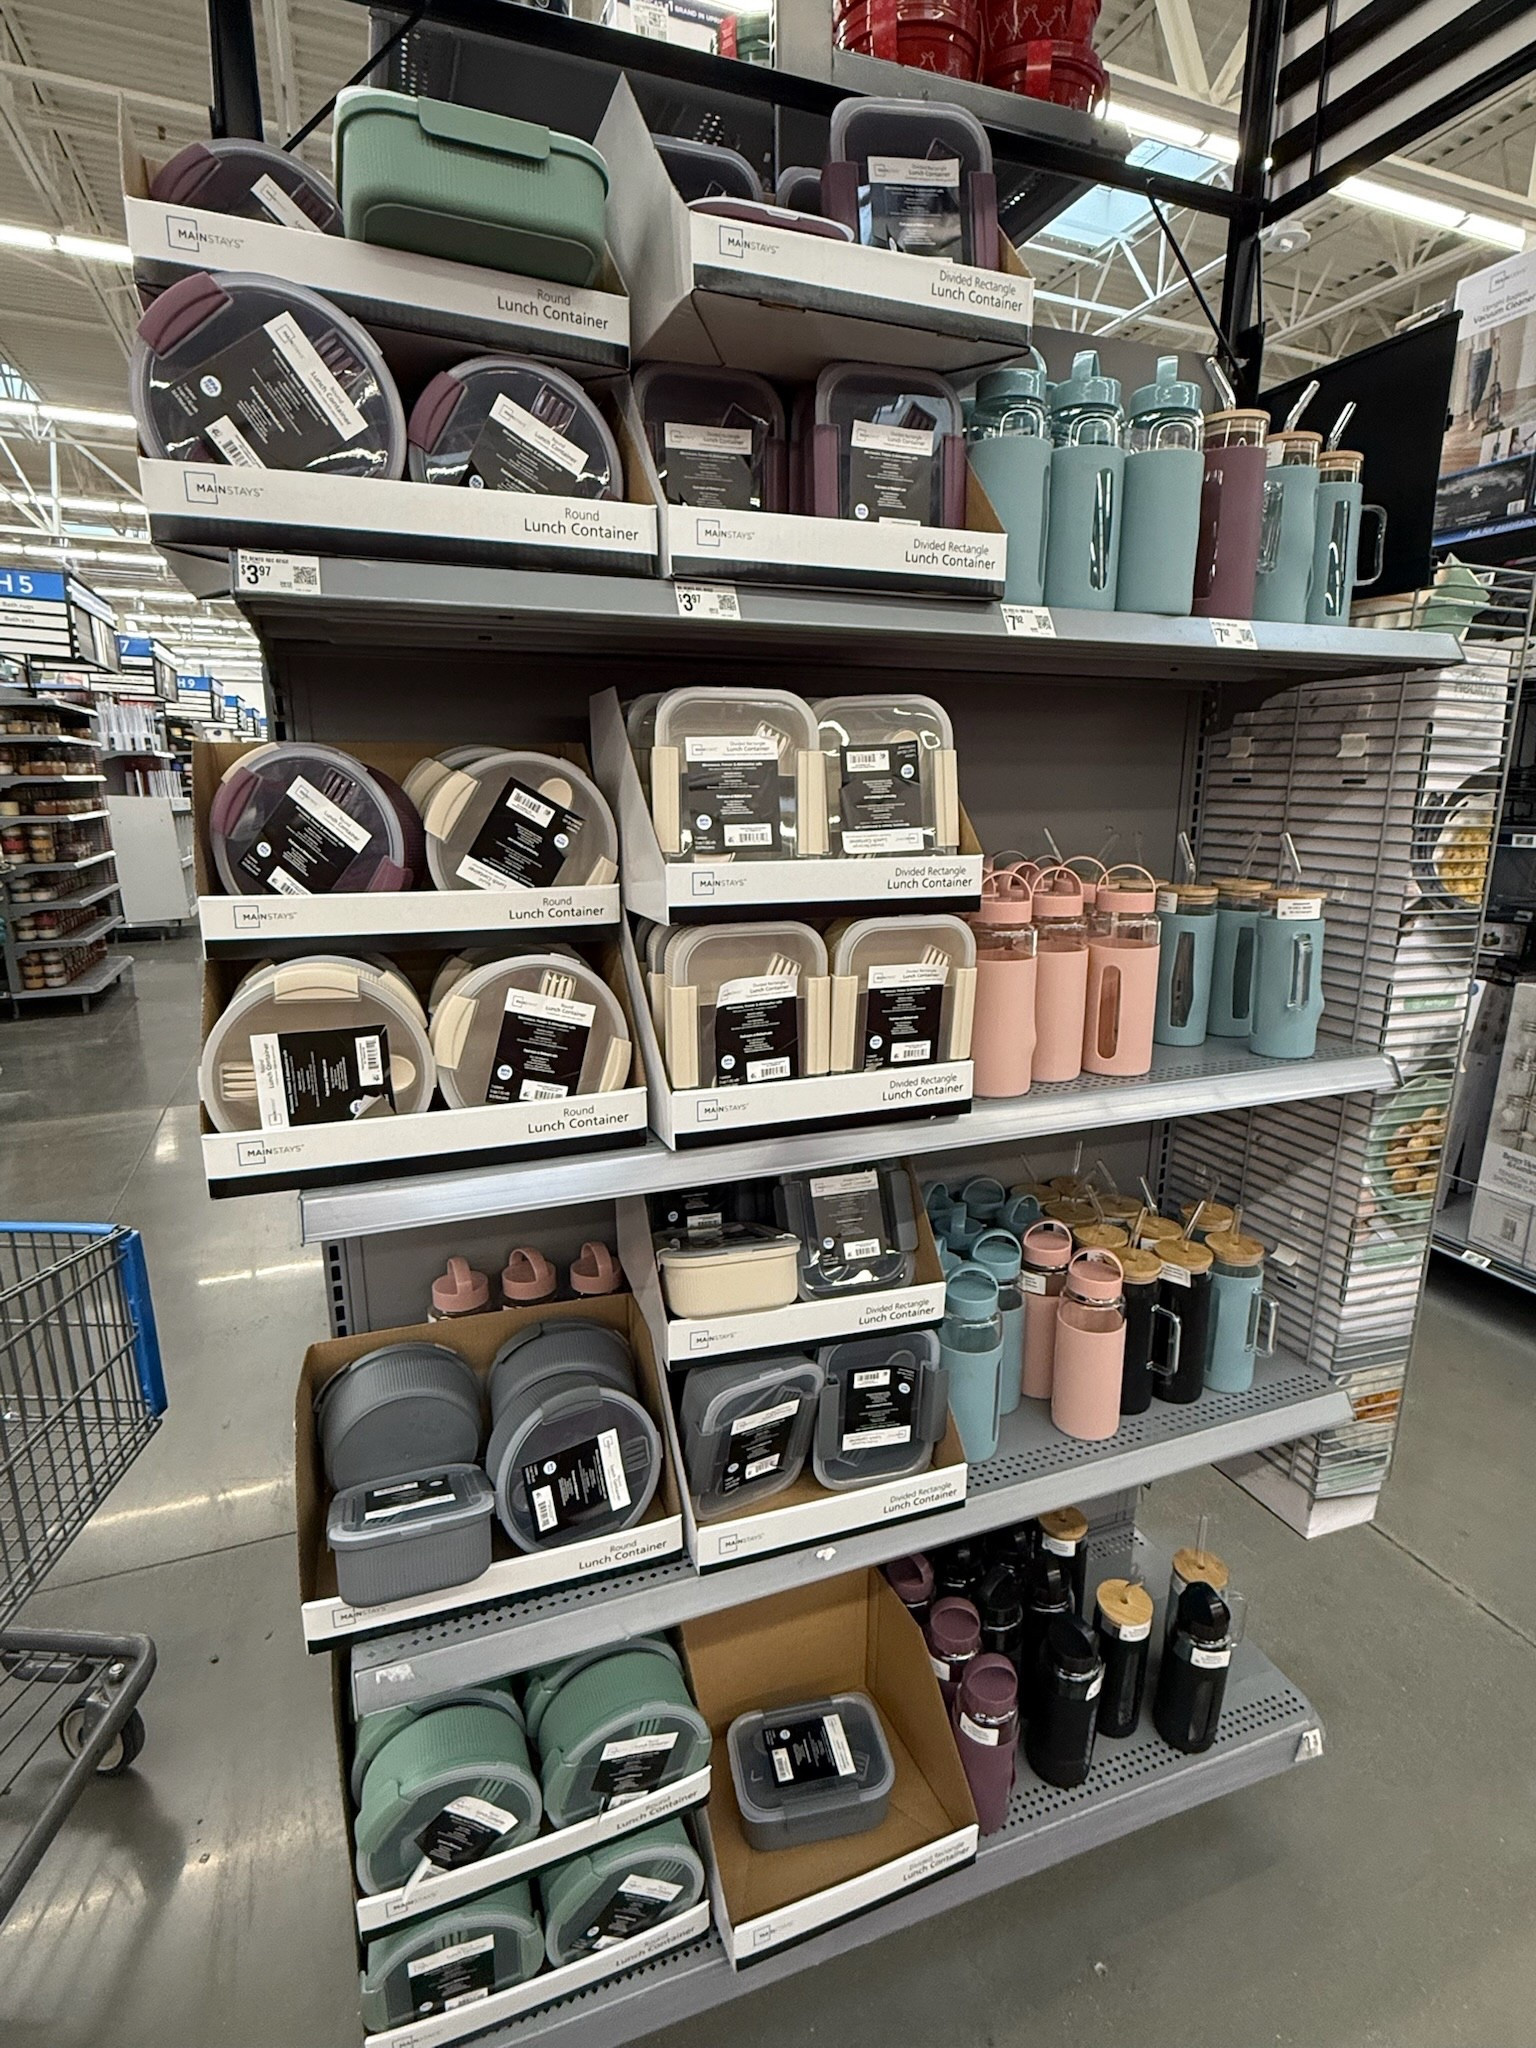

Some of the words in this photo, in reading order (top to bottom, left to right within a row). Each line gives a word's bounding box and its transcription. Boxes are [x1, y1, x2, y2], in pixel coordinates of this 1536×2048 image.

[939, 269, 972, 287] Divided
[974, 277, 1016, 296] Rectangle
[537, 288, 571, 306] Round
[931, 282, 965, 302] Lunch
[968, 289, 1023, 313] Container
[497, 296, 539, 317] Lunch
[543, 305, 608, 330] Container
[565, 507, 600, 522] Round
[523, 518, 566, 536] Lunch
[571, 522, 639, 541] Container
[913, 537, 946, 552] Divided
[948, 541, 989, 556] Rectangle
[904, 550, 938, 565] Lunch
[942, 554, 996, 570] Container
[894, 867, 926, 877] Divided
[927, 866, 967, 878] Rectangle
[887, 879, 919, 890] Lunch
[922, 878, 973, 889] Container
[542, 896, 573, 906] Round
[509, 908, 544, 920] Lunch
[547, 907, 605, 919] Container
[889, 1079, 919, 1089] Divided
[920, 1073, 957, 1087] Rectangle
[882, 1089, 913, 1102] Lunch
[915, 1083, 964, 1098] Container
[563, 1105, 595, 1117] Round
[528, 1121, 565, 1134] Lunch
[569, 1113, 629, 1129] Container
[865, 1303, 894, 1315] Divided
[894, 1298, 930, 1312] Rectangle
[858, 1314, 887, 1326] Lunch
[890, 1307, 936, 1320] Container
[883, 1501, 912, 1514] Lunch
[913, 1488, 958, 1506] Container
[889, 1489, 917, 1503] Divided
[918, 1481, 953, 1496] Rectangle
[578, 1554, 612, 1571] Lunch
[614, 1540, 668, 1561] Container
[609, 1539, 637, 1553] Round
[616, 1813, 648, 1831] Lunch
[649, 1790, 698, 1817] Container
[903, 1865, 929, 1882] Lunch
[929, 1845, 970, 1869] Container
[615, 1949, 646, 1967] Lunch
[647, 1925, 697, 1954] Container
